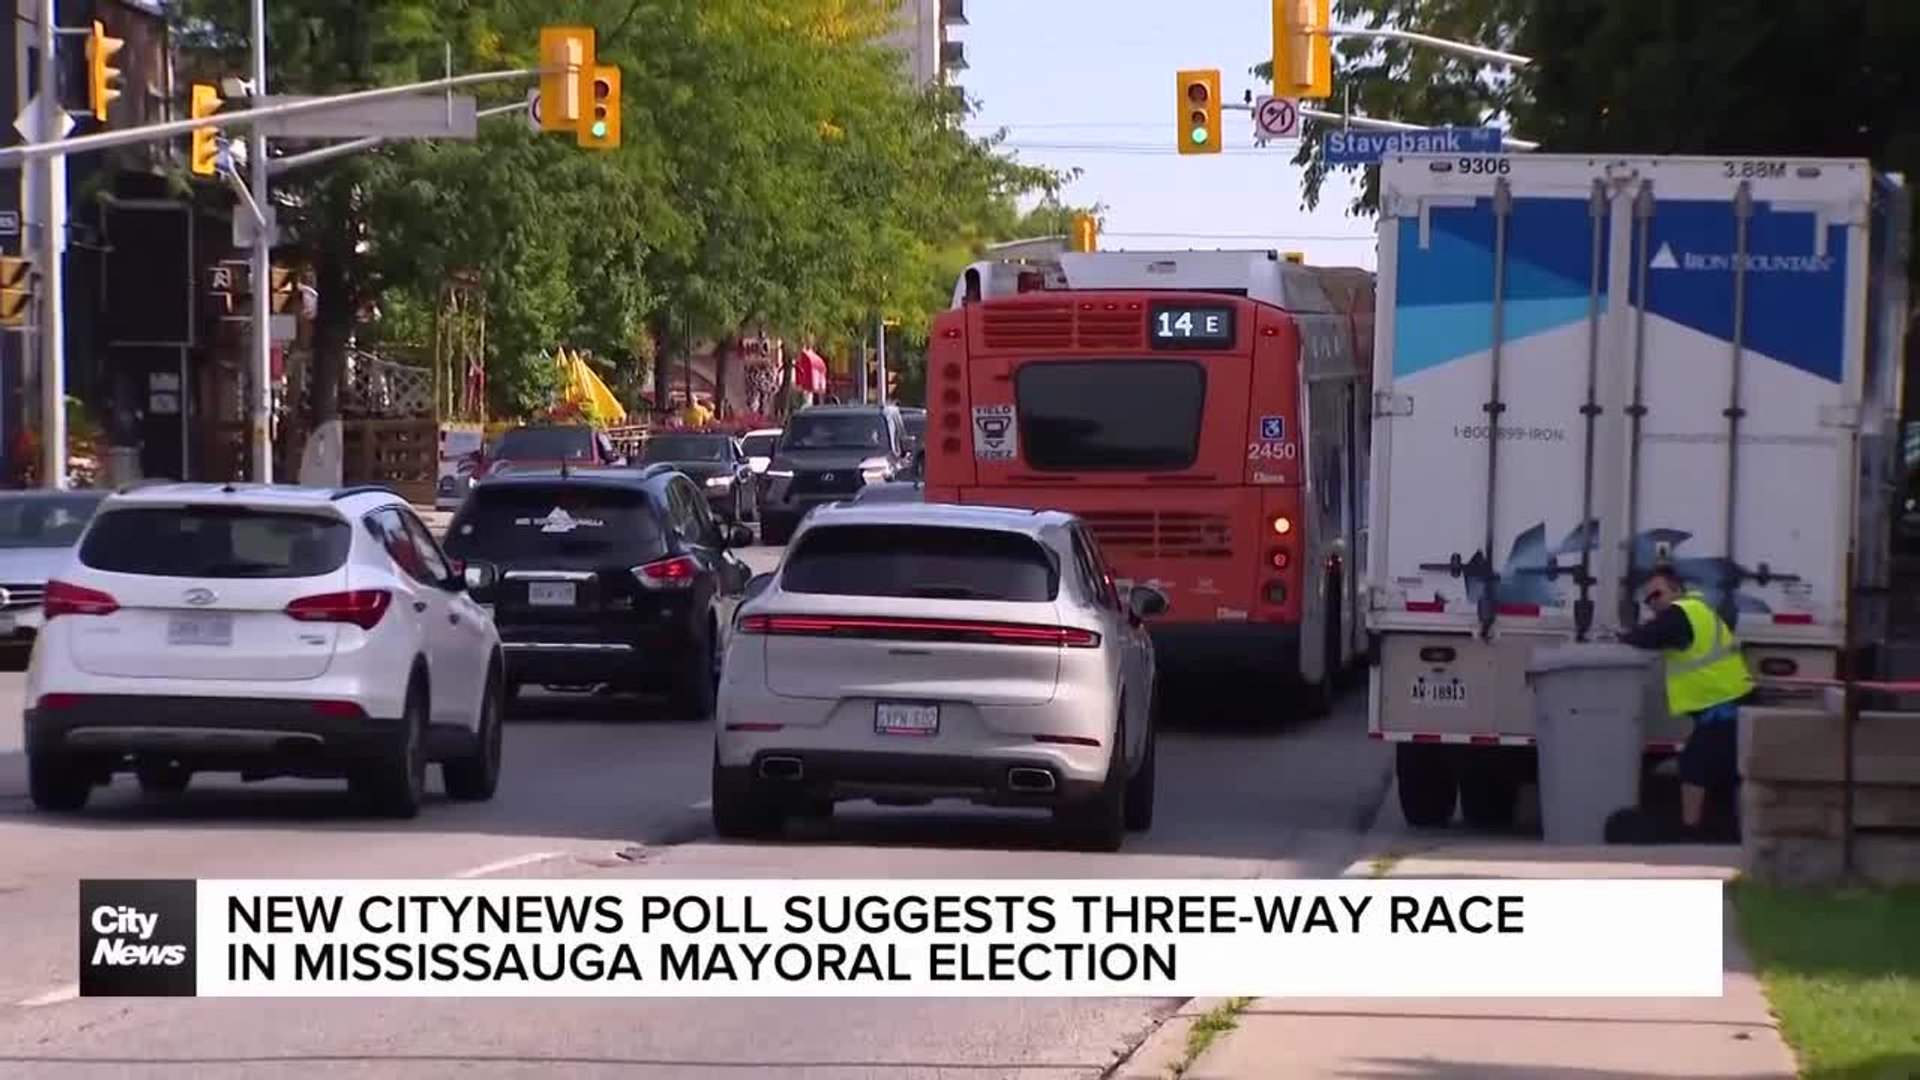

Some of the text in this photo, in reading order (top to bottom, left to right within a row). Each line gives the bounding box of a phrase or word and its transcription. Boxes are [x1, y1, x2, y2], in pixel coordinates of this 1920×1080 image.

[1329, 129, 1461, 153] Stavebank
[1459, 158, 1511, 175] 9306
[1723, 160, 1787, 178] 3.88M
[1685, 252, 1729, 271] IRON
[1158, 312, 1219, 337] 14 E
[976, 405, 1011, 414] YIELD
[1247, 443, 1296, 460] 2450
